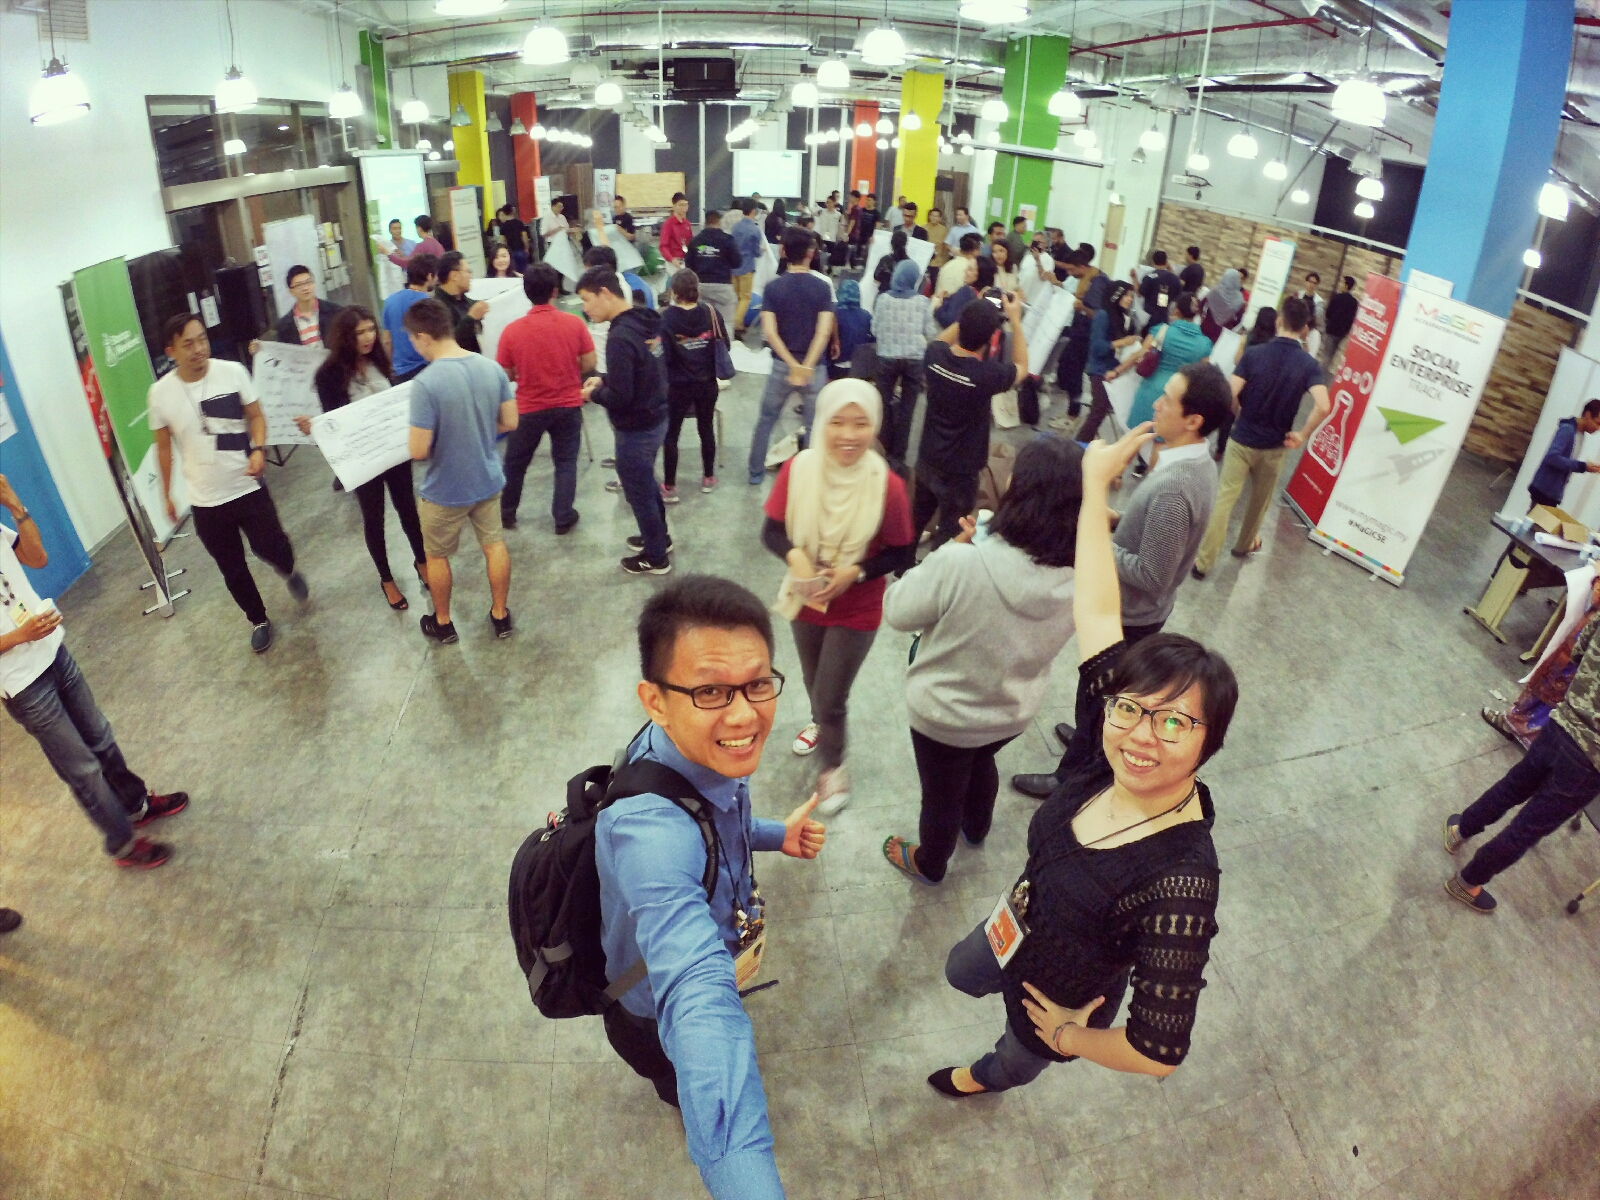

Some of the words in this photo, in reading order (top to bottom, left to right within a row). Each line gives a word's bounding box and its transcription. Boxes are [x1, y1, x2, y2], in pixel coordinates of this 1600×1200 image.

[1389, 353, 1473, 398] ENTERPRISE
[1410, 345, 1460, 376] SOCIAL
[1409, 378, 1443, 401] TRACK
[1335, 500, 1408, 543] www.mymagic.my
